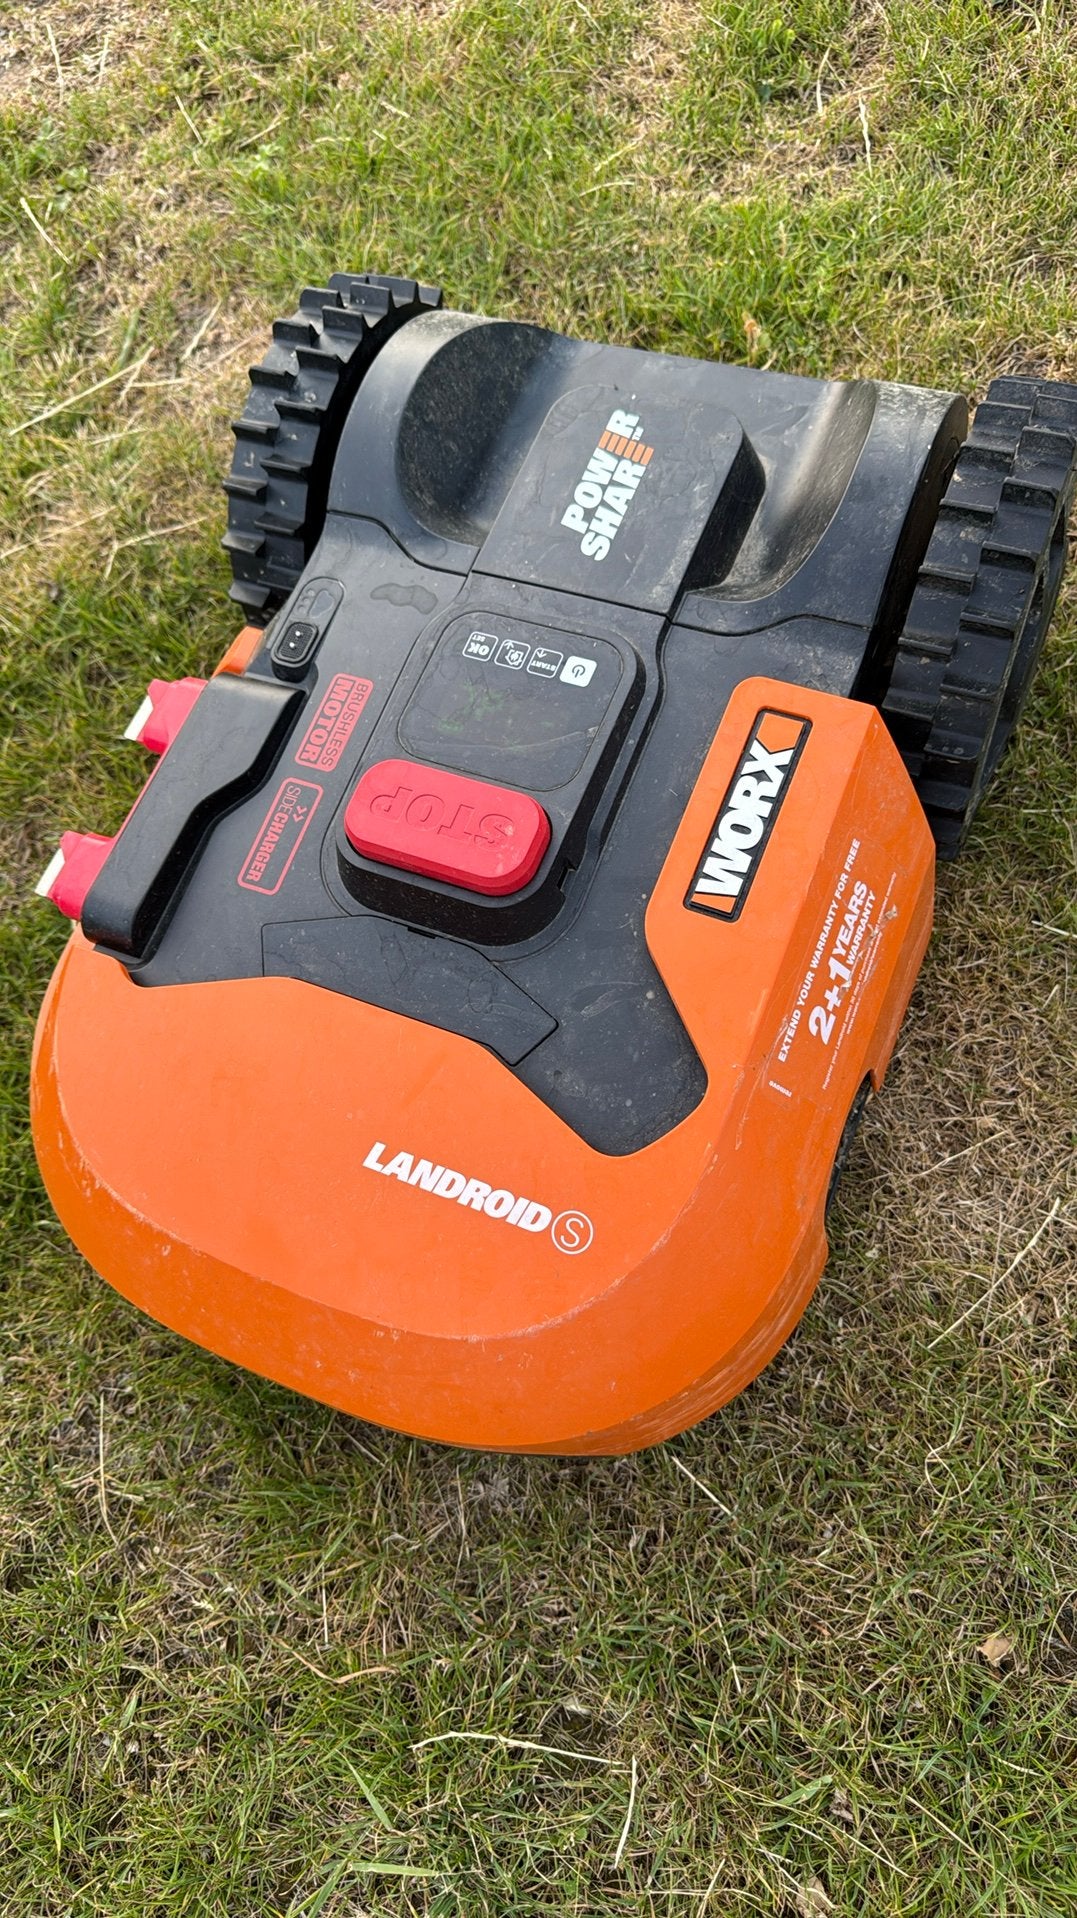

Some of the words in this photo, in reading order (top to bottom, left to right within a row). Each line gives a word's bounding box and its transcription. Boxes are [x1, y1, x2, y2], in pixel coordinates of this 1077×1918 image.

[561, 409, 640, 534] POWER
[580, 438, 655, 561] SHARE
[467, 642, 490, 656] OK
[531, 660, 557, 672] START
[300, 678, 354, 762] MOTOR
[321, 683, 369, 767] BRUSHLESS
[370, 786, 516, 848] STOP
[694, 740, 795, 897] WORX
[777, 1009, 801, 1062] EXTEND
[797, 971, 815, 1006] YOUR
[810, 900, 839, 969] WARRANTY
[834, 873, 849, 900] FOR
[844, 838, 860, 872] FREE
[832, 881, 867, 957] YEARS
[846, 890, 876, 965] WARRANTY
[362, 1141, 552, 1233] LANDROID
